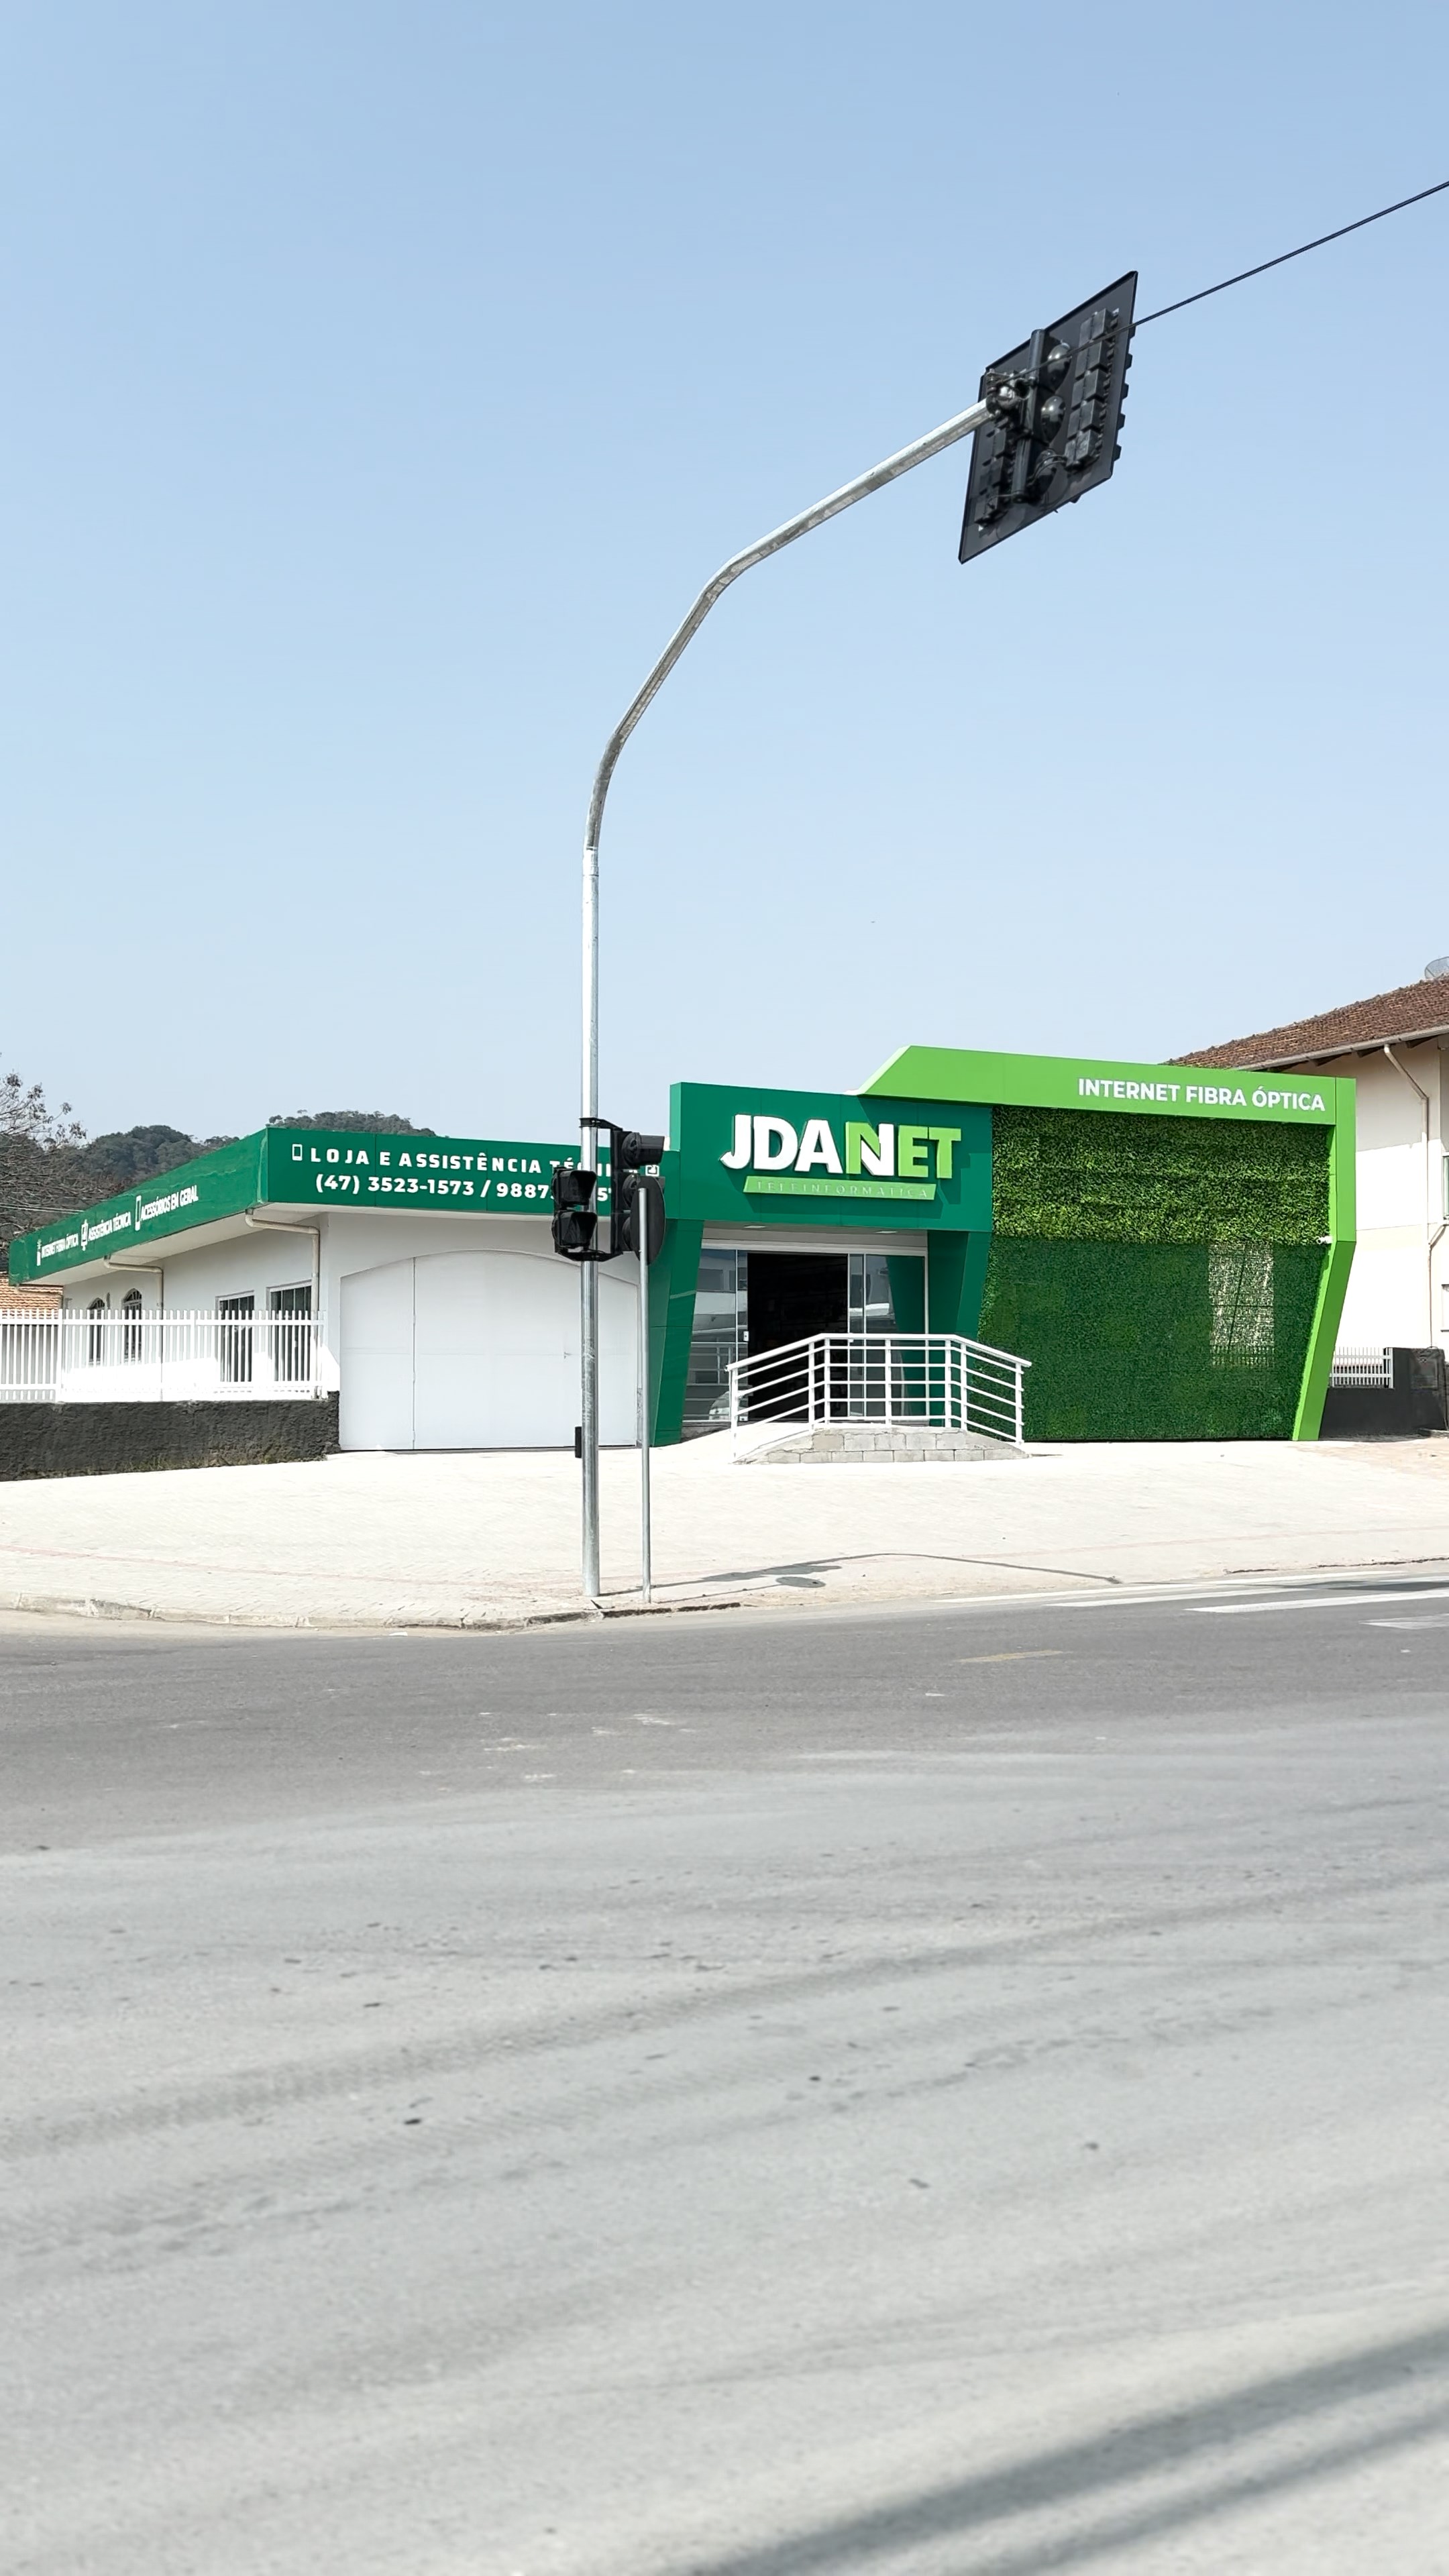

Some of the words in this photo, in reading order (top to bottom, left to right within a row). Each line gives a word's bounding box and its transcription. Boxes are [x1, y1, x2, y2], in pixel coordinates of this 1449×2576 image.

[1079, 1078, 1180, 1102] INTERNET
[1186, 1085, 1247, 1107] FIBRA
[1252, 1085, 1326, 1112] ÓPTICA
[719, 1114, 961, 1179] JDANET
[311, 1148, 369, 1165] LOJA
[380, 1151, 390, 1166] E
[398, 1152, 542, 1174] ASSISTÊNCIA
[180, 1185, 199, 1207] GERAL
[316, 1174, 360, 1195] (47)
[368, 1177, 474, 1196] 3523-1573
